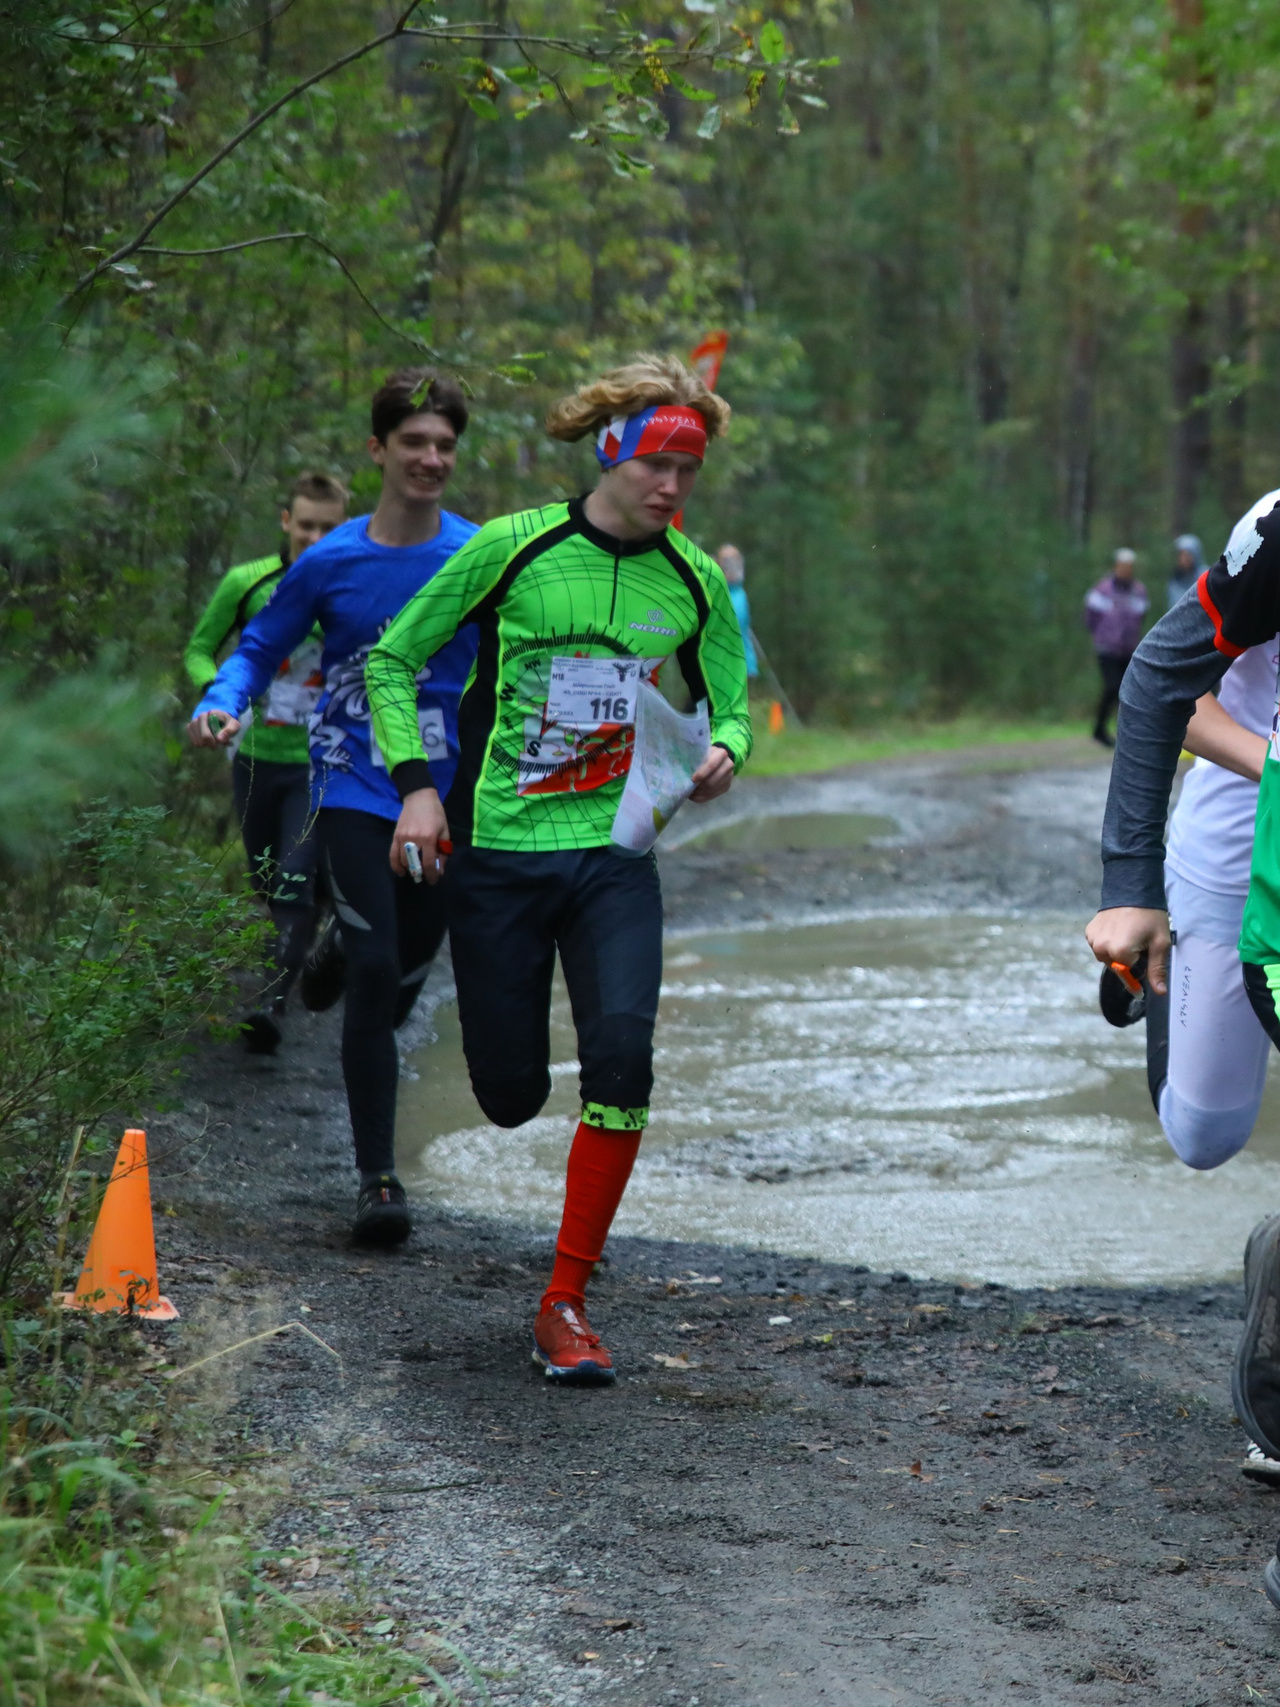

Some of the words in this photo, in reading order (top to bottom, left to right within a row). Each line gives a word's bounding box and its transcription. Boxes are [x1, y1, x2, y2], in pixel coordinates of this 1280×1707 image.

[629, 621, 677, 637] NORD
[590, 697, 629, 720] 116
[527, 740, 541, 757] S
